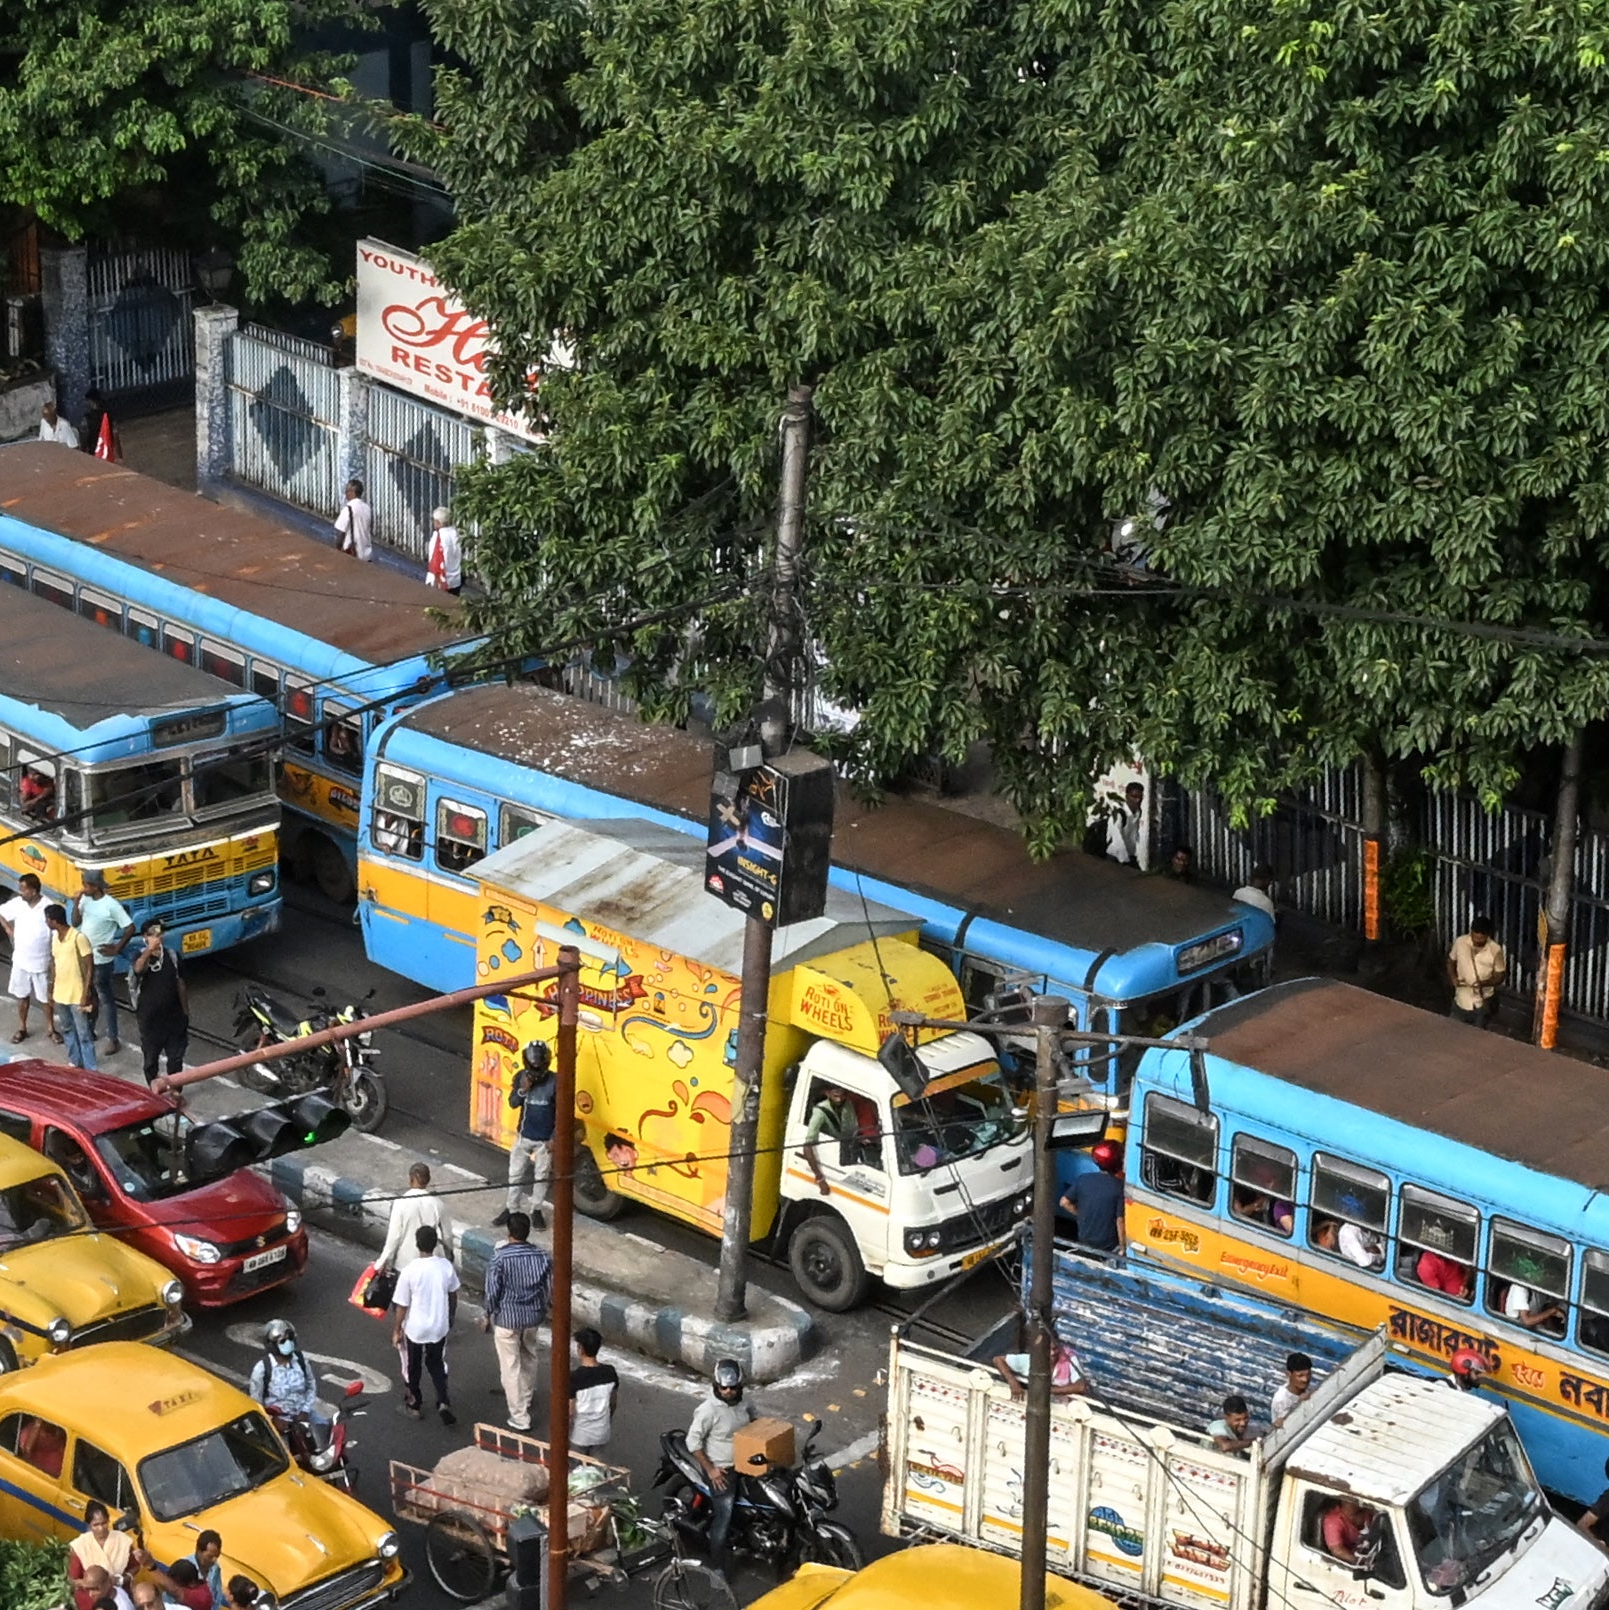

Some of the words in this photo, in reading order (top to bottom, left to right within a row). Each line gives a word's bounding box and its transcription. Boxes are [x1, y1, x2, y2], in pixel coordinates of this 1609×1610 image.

[359, 249, 436, 288] YOUTH
[391, 345, 495, 399] RESTA
[164, 847, 215, 866] TATA
[805, 986, 831, 1011] ROTI
[800, 998, 853, 1032] WHEELS
[162, 1391, 191, 1408] TAXI
